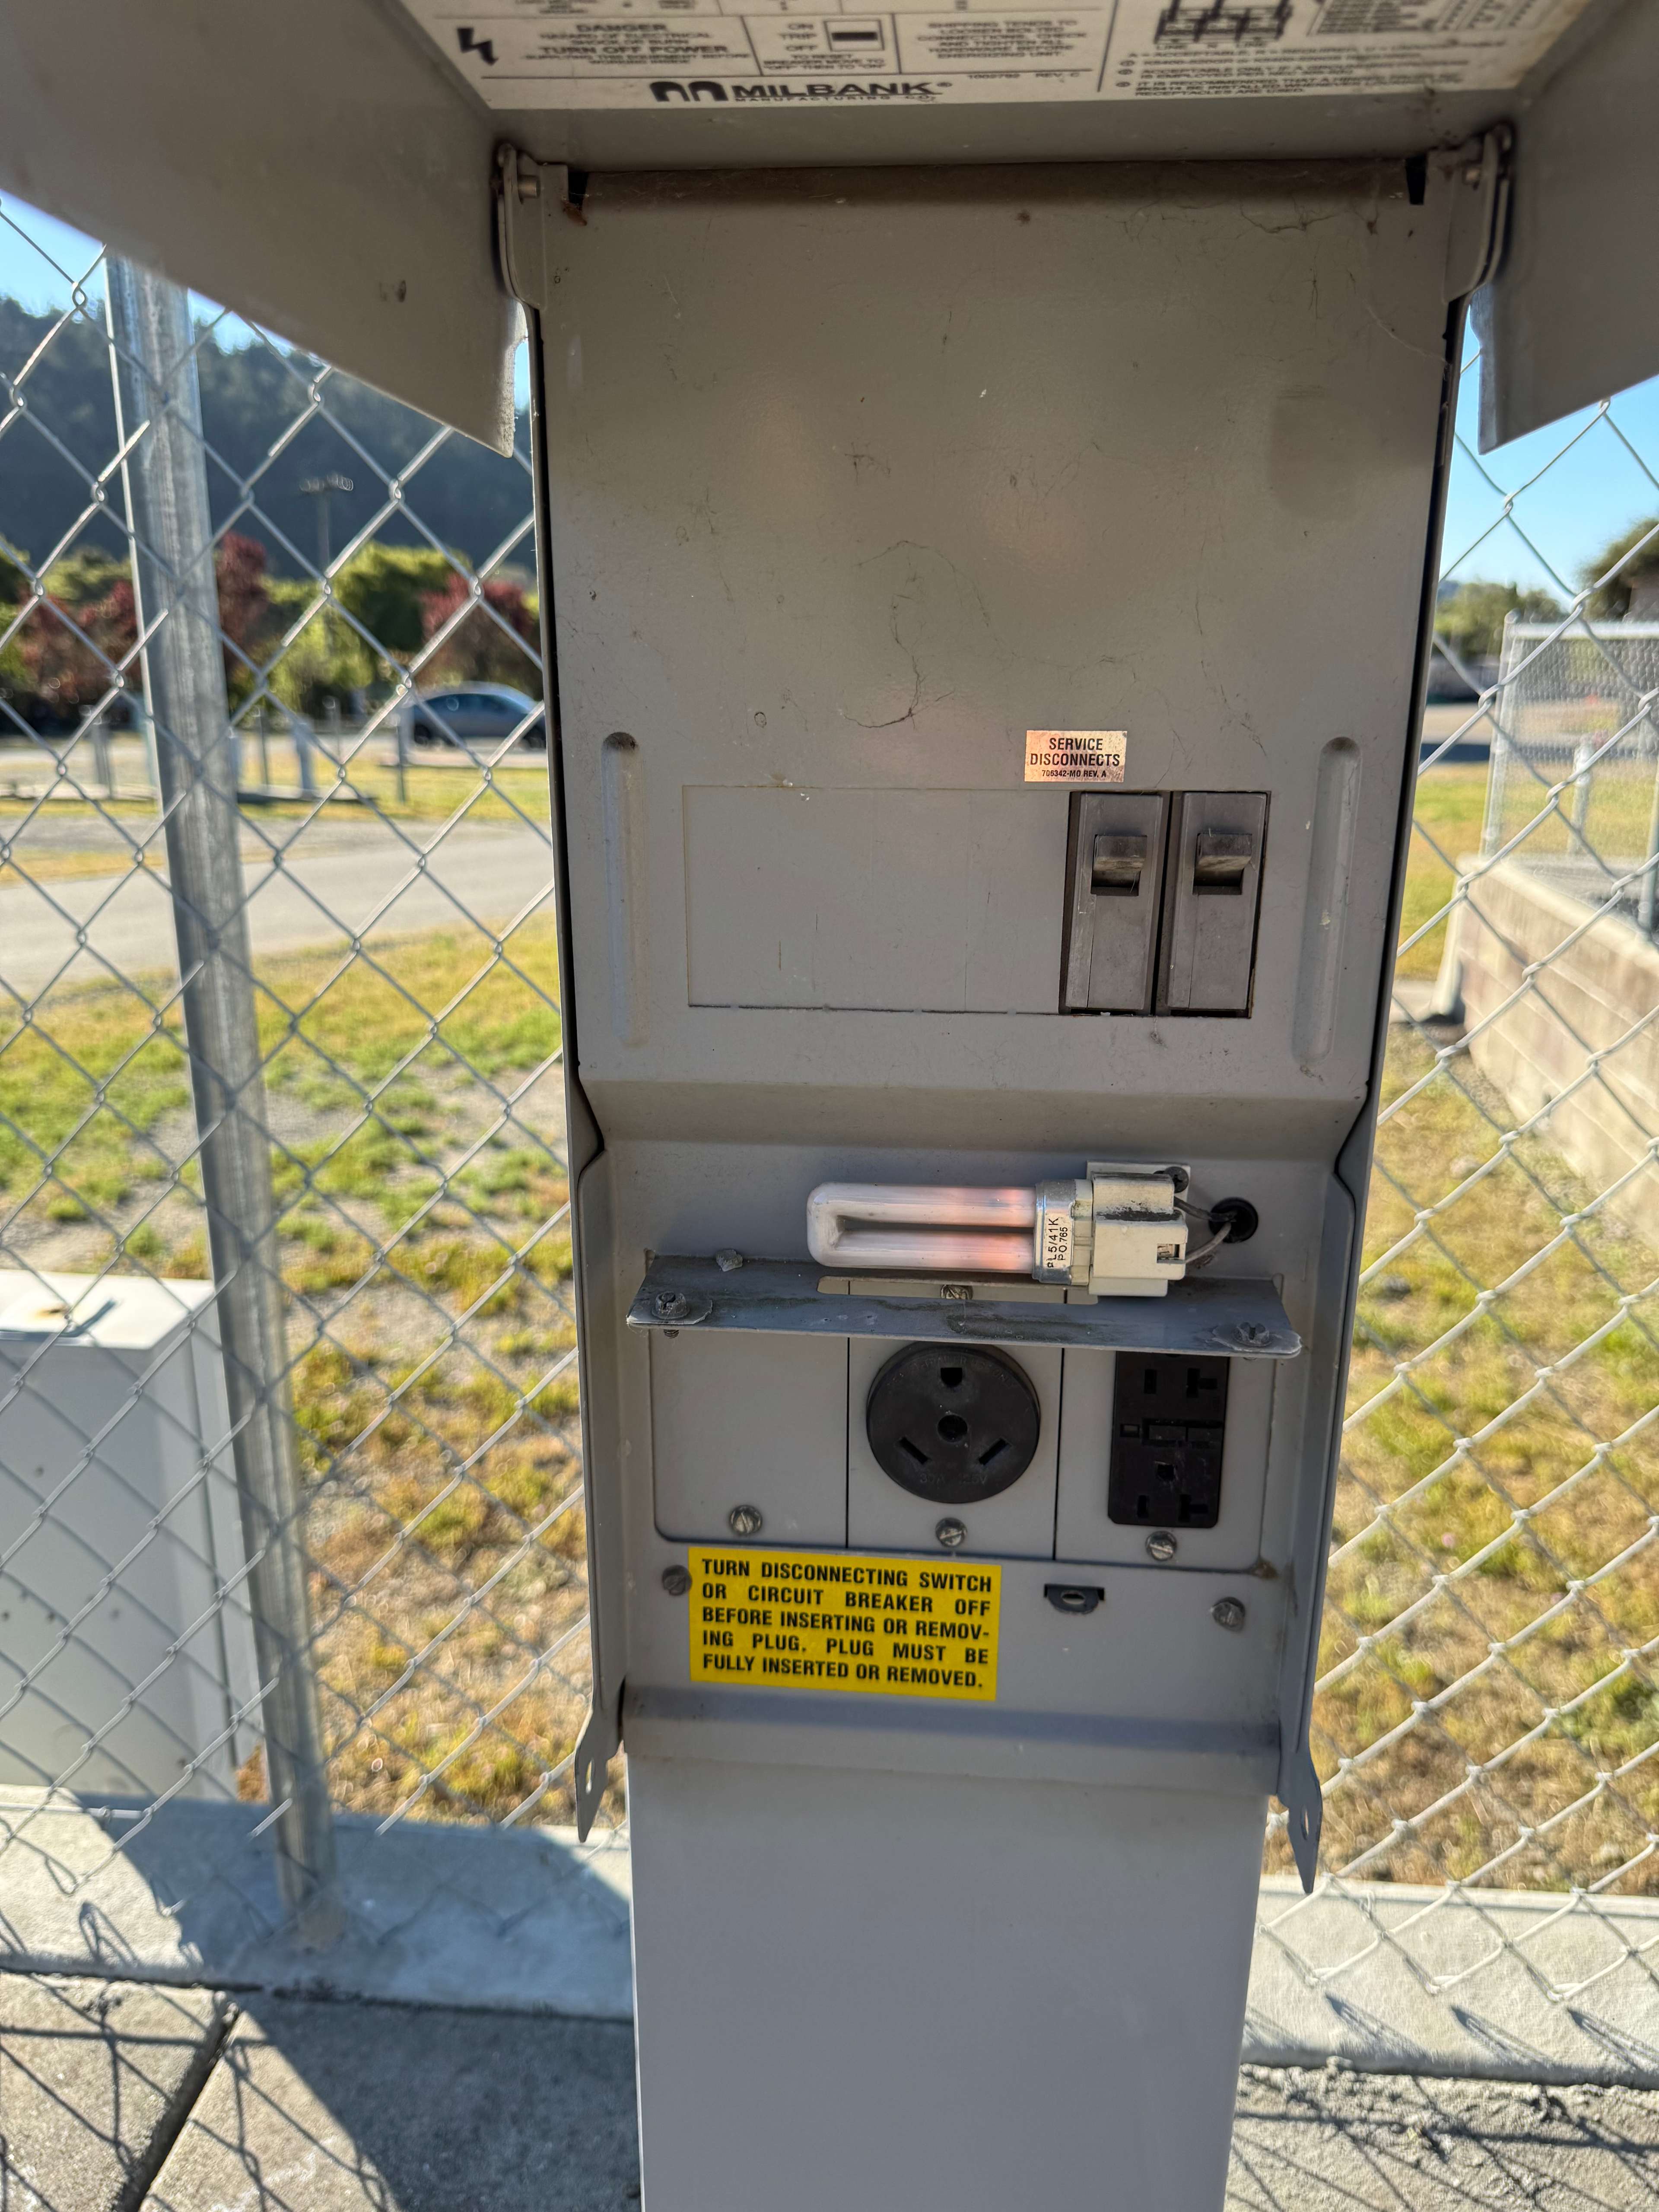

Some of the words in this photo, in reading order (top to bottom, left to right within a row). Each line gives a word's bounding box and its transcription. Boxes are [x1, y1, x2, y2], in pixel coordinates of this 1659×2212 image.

[732, 82, 938, 98] MILBANK
[1030, 753, 1120, 766] DISCONNECTS
[1049, 737, 1103, 751] SERVICE
[702, 1558, 750, 1577] TURN
[761, 1562, 908, 1587] DISCONNECTING
[919, 1572, 992, 1592] SWITCH
[702, 1583, 727, 1599] OR
[748, 1585, 824, 1605] CIRCUIT
[845, 1591, 933, 1613] BREAKER
[954, 1599, 991, 1617] OFF
[702, 1606, 772, 1626] BEFORE
[780, 1611, 875, 1633] INSERTING
[883, 1618, 908, 1635] OR
[915, 1620, 989, 1640] REMOV-
[702, 1630, 734, 1647] ING
[752, 1633, 807, 1652] PLUG.
[826, 1637, 874, 1656] PLUG
[892, 1642, 946, 1662] MUST
[964, 1647, 988, 1664] BE
[702, 1653, 755, 1672] FULLY
[762, 1656, 849, 1678] INSERTED
[855, 1663, 880, 1680] OR
[886, 1665, 983, 1688] REMOVED.
